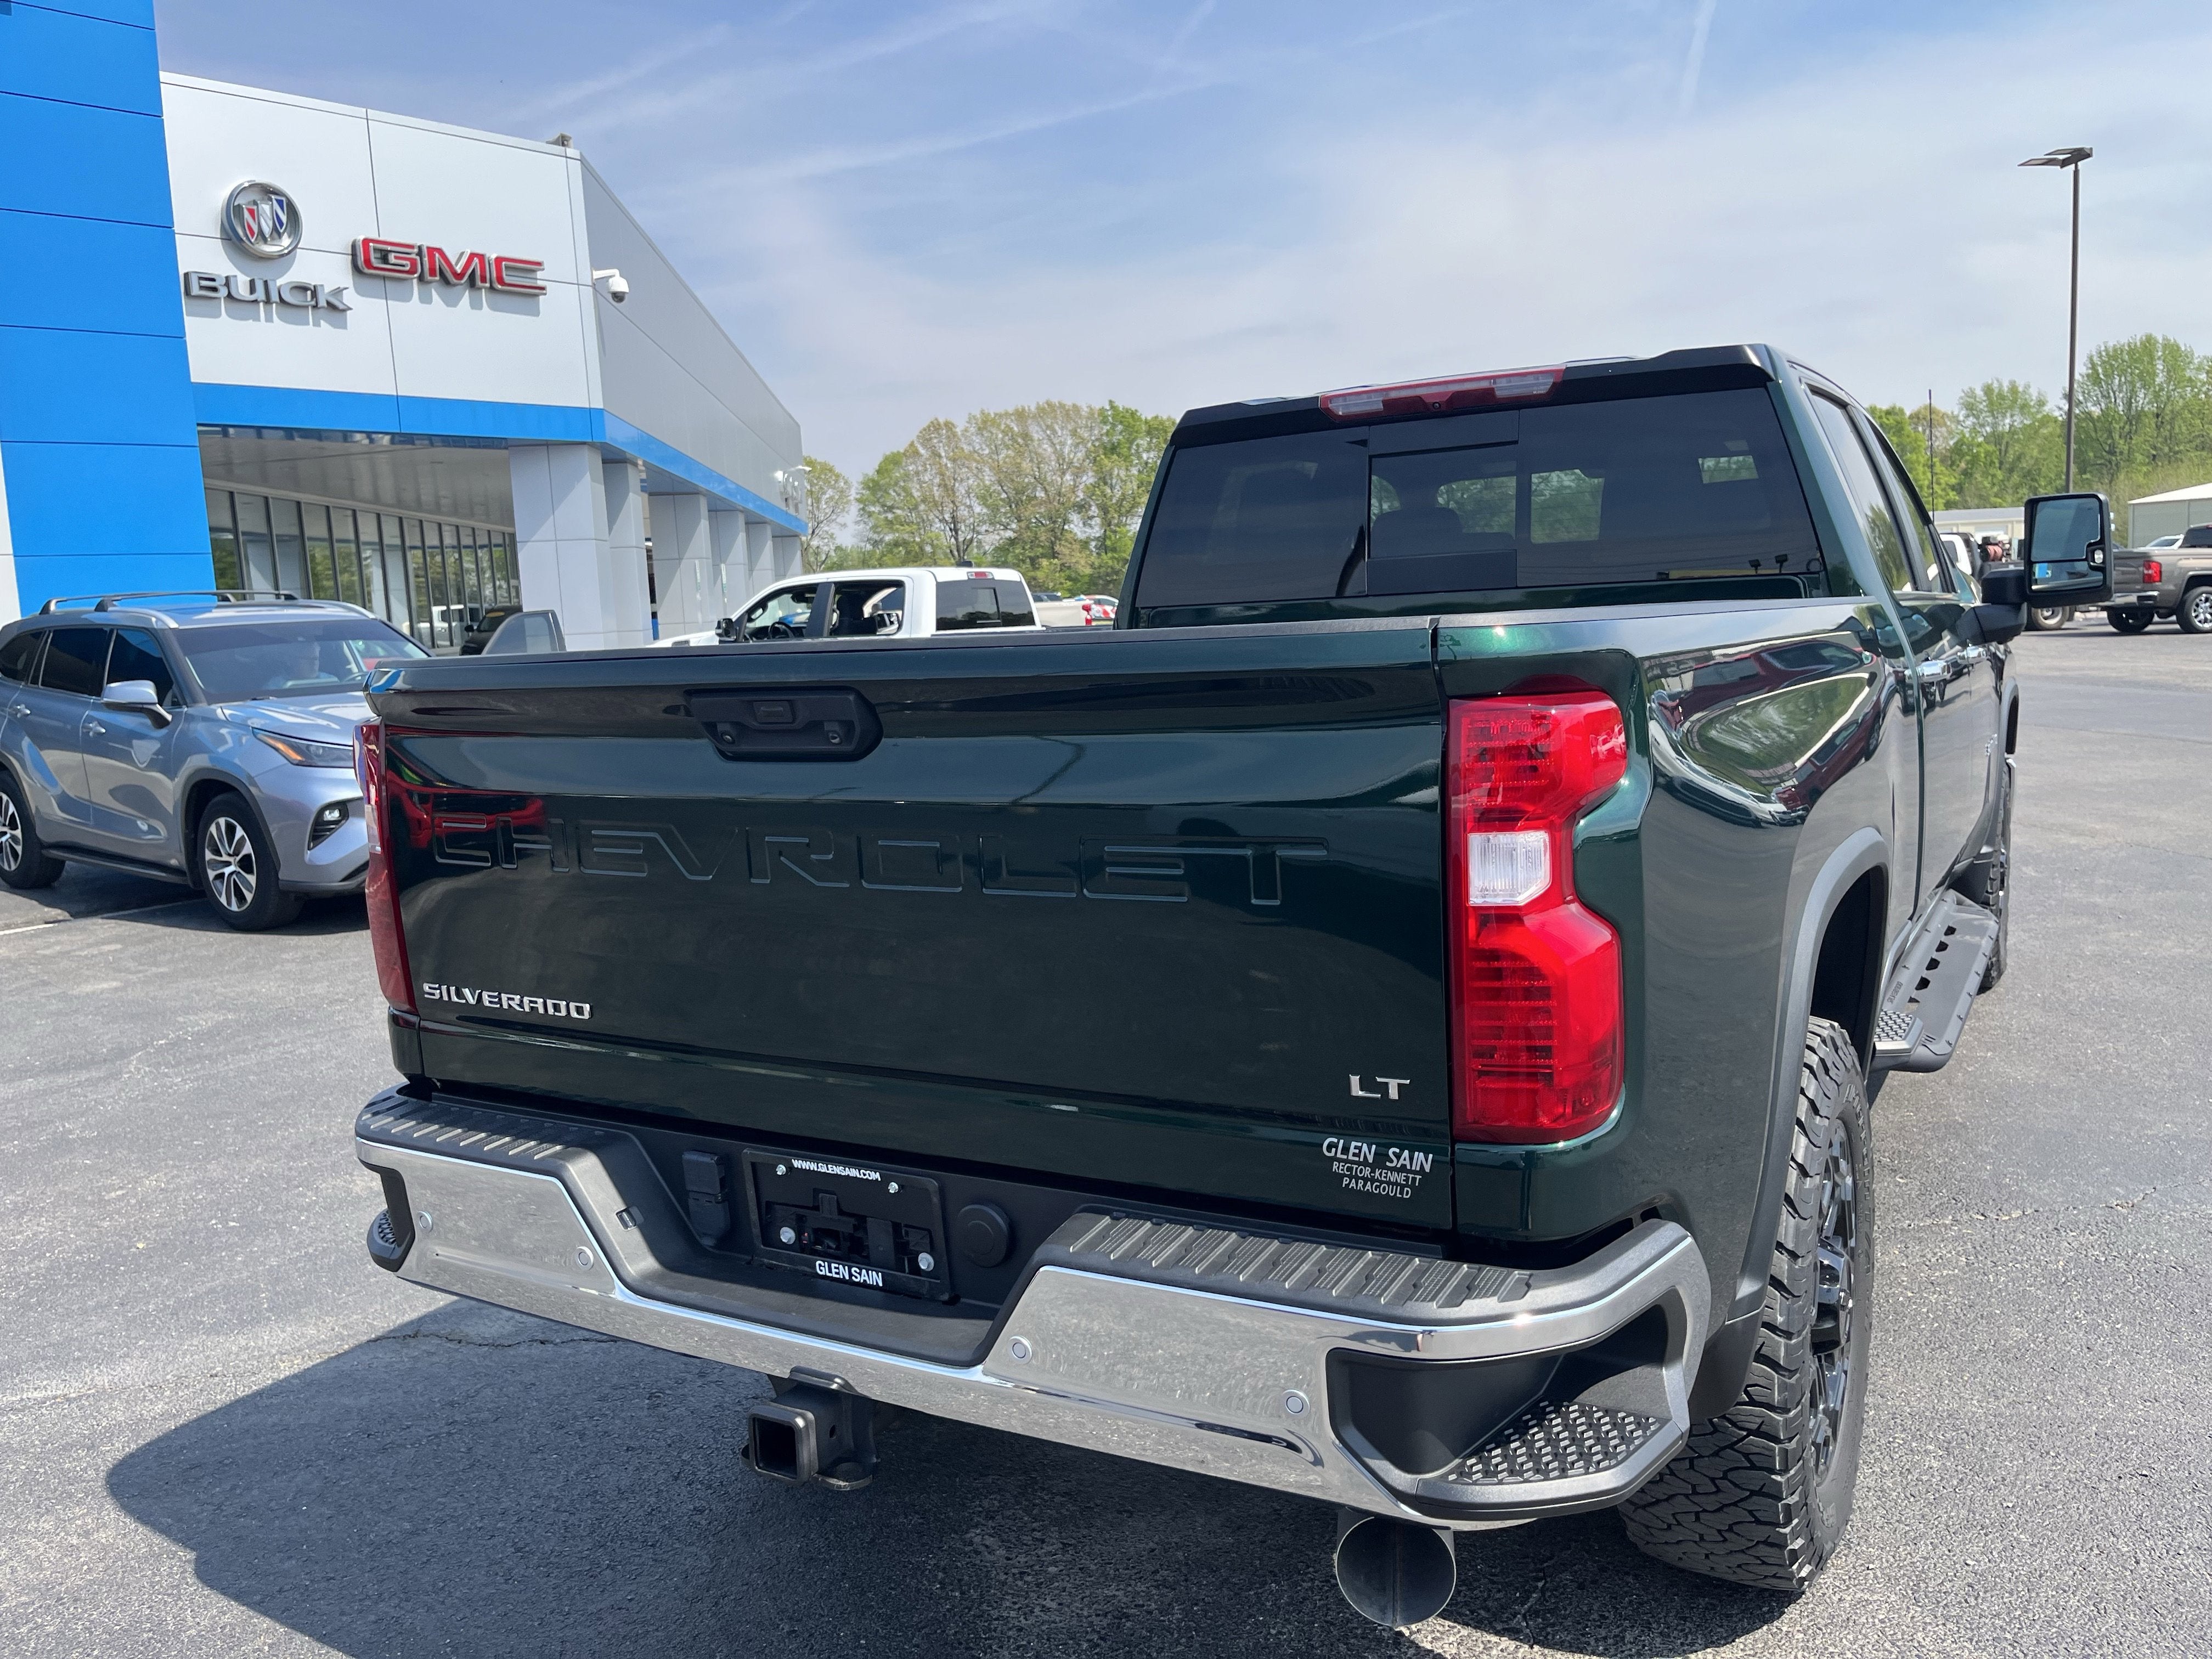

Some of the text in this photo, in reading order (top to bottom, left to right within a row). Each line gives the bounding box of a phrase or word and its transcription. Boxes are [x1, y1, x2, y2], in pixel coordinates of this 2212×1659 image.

[352, 235, 548, 296] GMC
[184, 271, 353, 311] BUICK
[433, 812, 1329, 906] CHEVROLET
[423, 983, 592, 1020] SILVERADO
[1349, 1074, 1410, 1099] LT
[1322, 1137, 1433, 1172] GLEN SAIN
[791, 1159, 881, 1181] WWW.GLENSAIN.COM
[1332, 1161, 1422, 1186] RECTOR-KENNETT
[1342, 1177, 1412, 1198] PARAGOULD
[815, 1261, 883, 1287] GLEN SAIN
